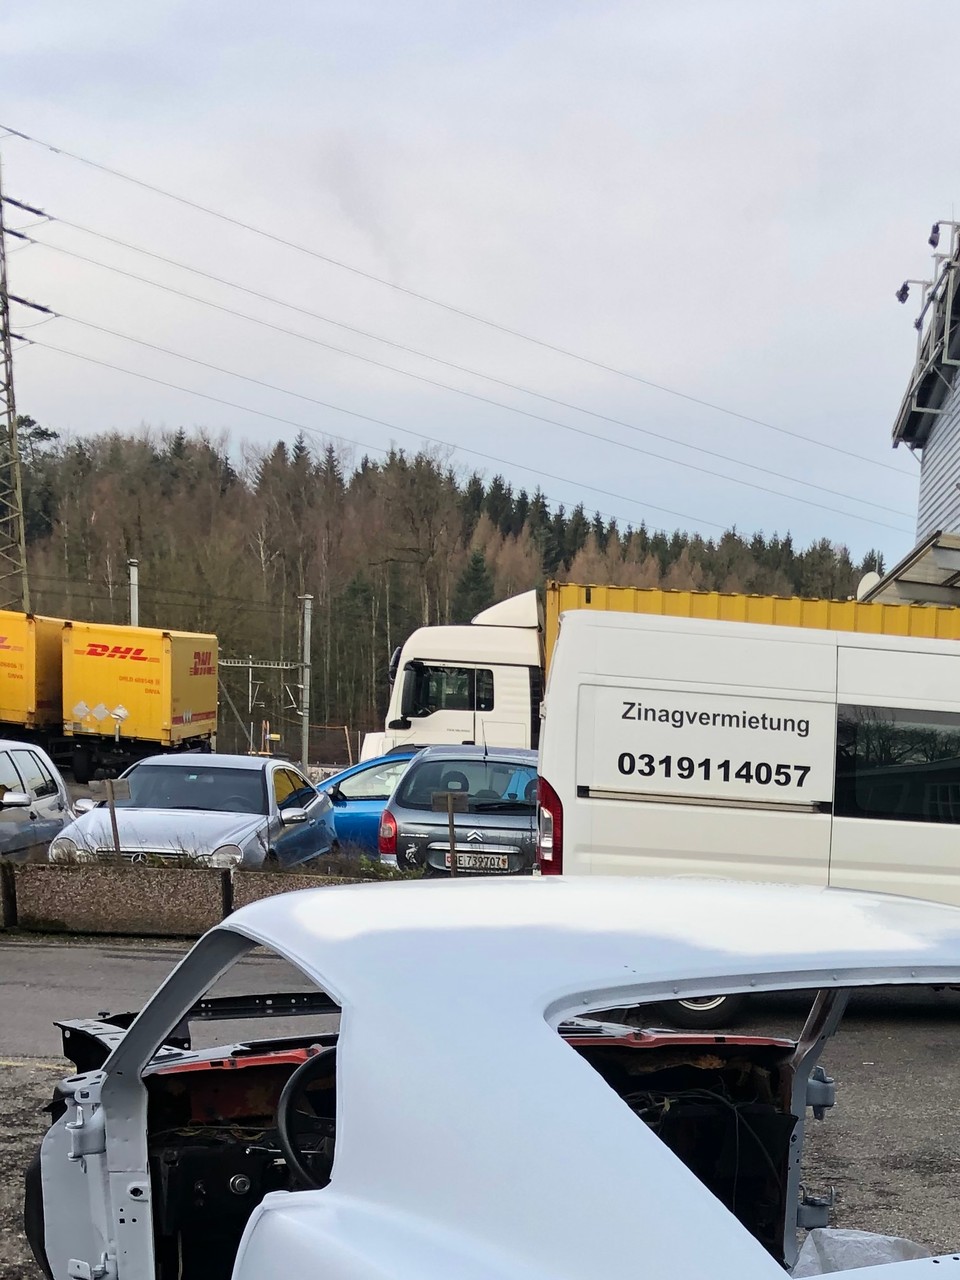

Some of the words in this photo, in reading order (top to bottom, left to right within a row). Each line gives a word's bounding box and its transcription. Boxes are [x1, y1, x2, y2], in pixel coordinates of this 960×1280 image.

[86, 643, 149, 662] DHL
[620, 701, 811, 738] Zinagvermietung
[617, 752, 812, 788] 0319114057
